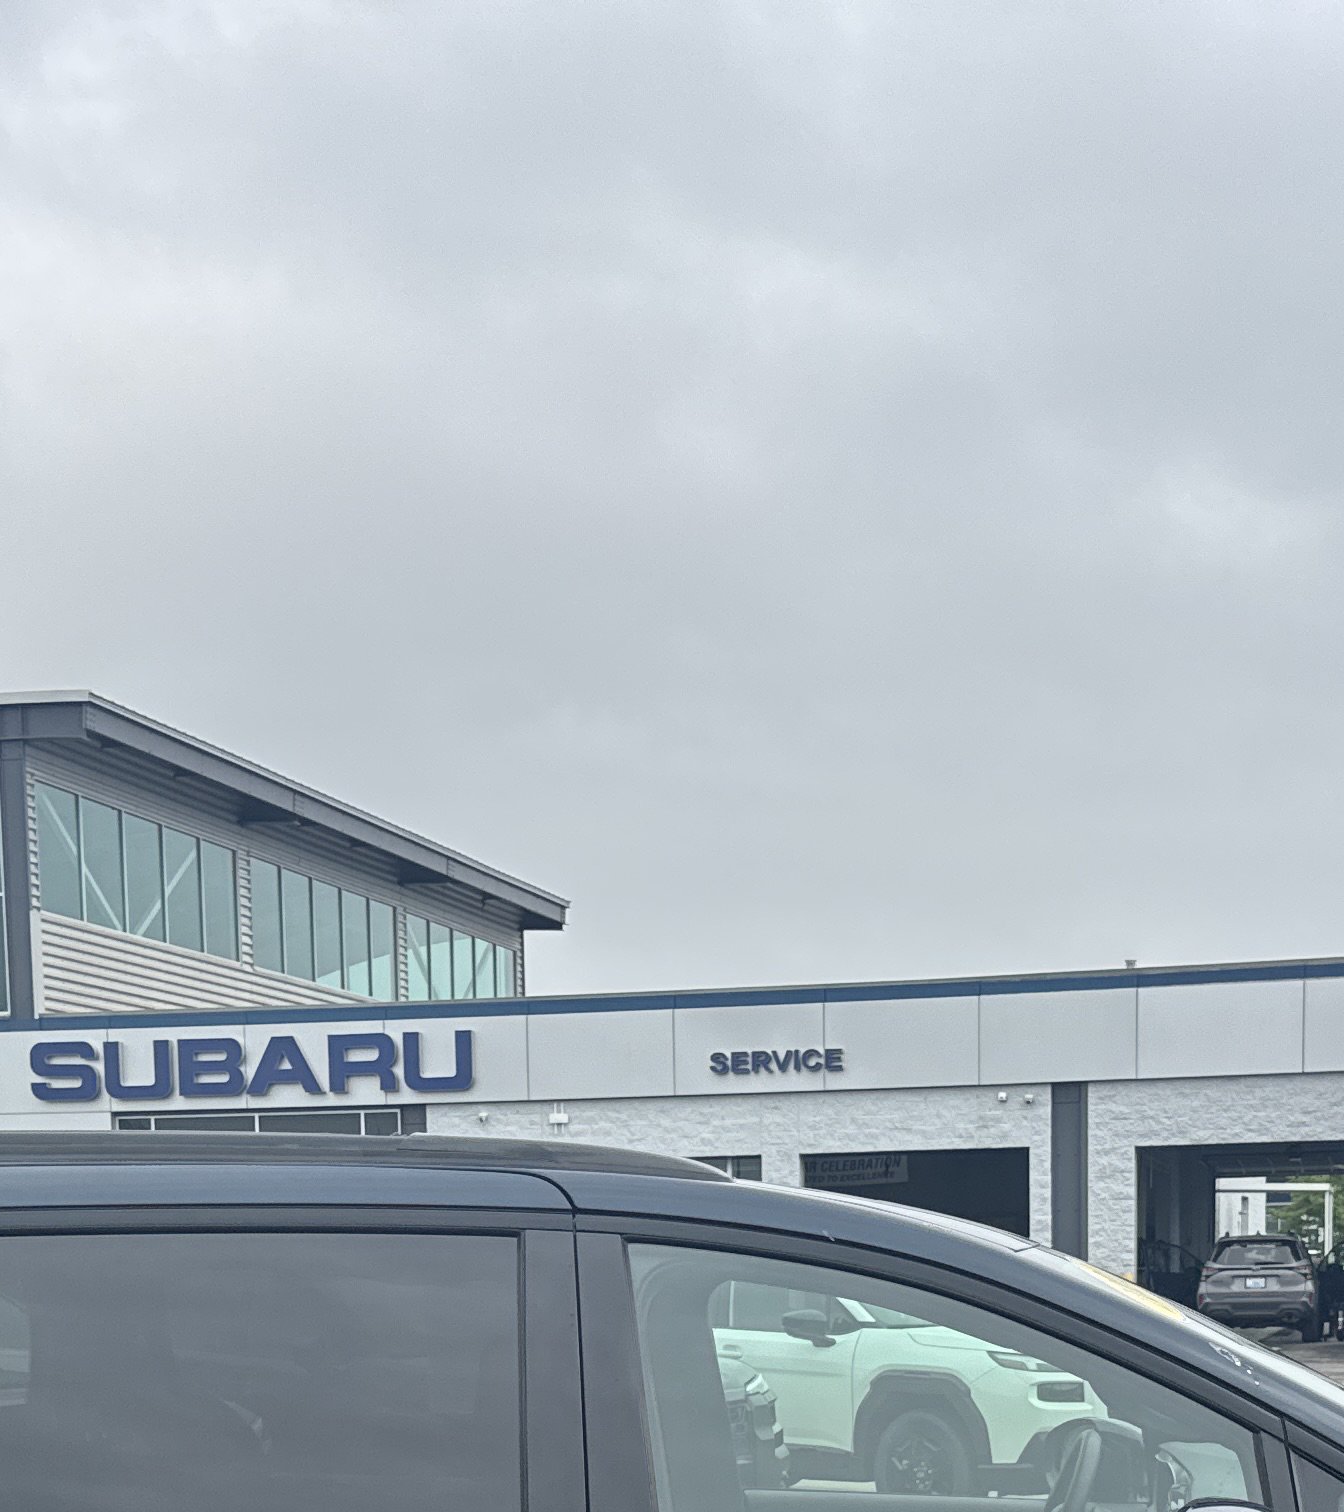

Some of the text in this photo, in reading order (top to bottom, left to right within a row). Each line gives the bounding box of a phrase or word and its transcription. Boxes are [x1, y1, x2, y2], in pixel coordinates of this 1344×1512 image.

[30, 1030, 474, 1101] SUBARU
[709, 1048, 844, 1075] SERVICE
[820, 1155, 901, 1172] CELEBRATION
